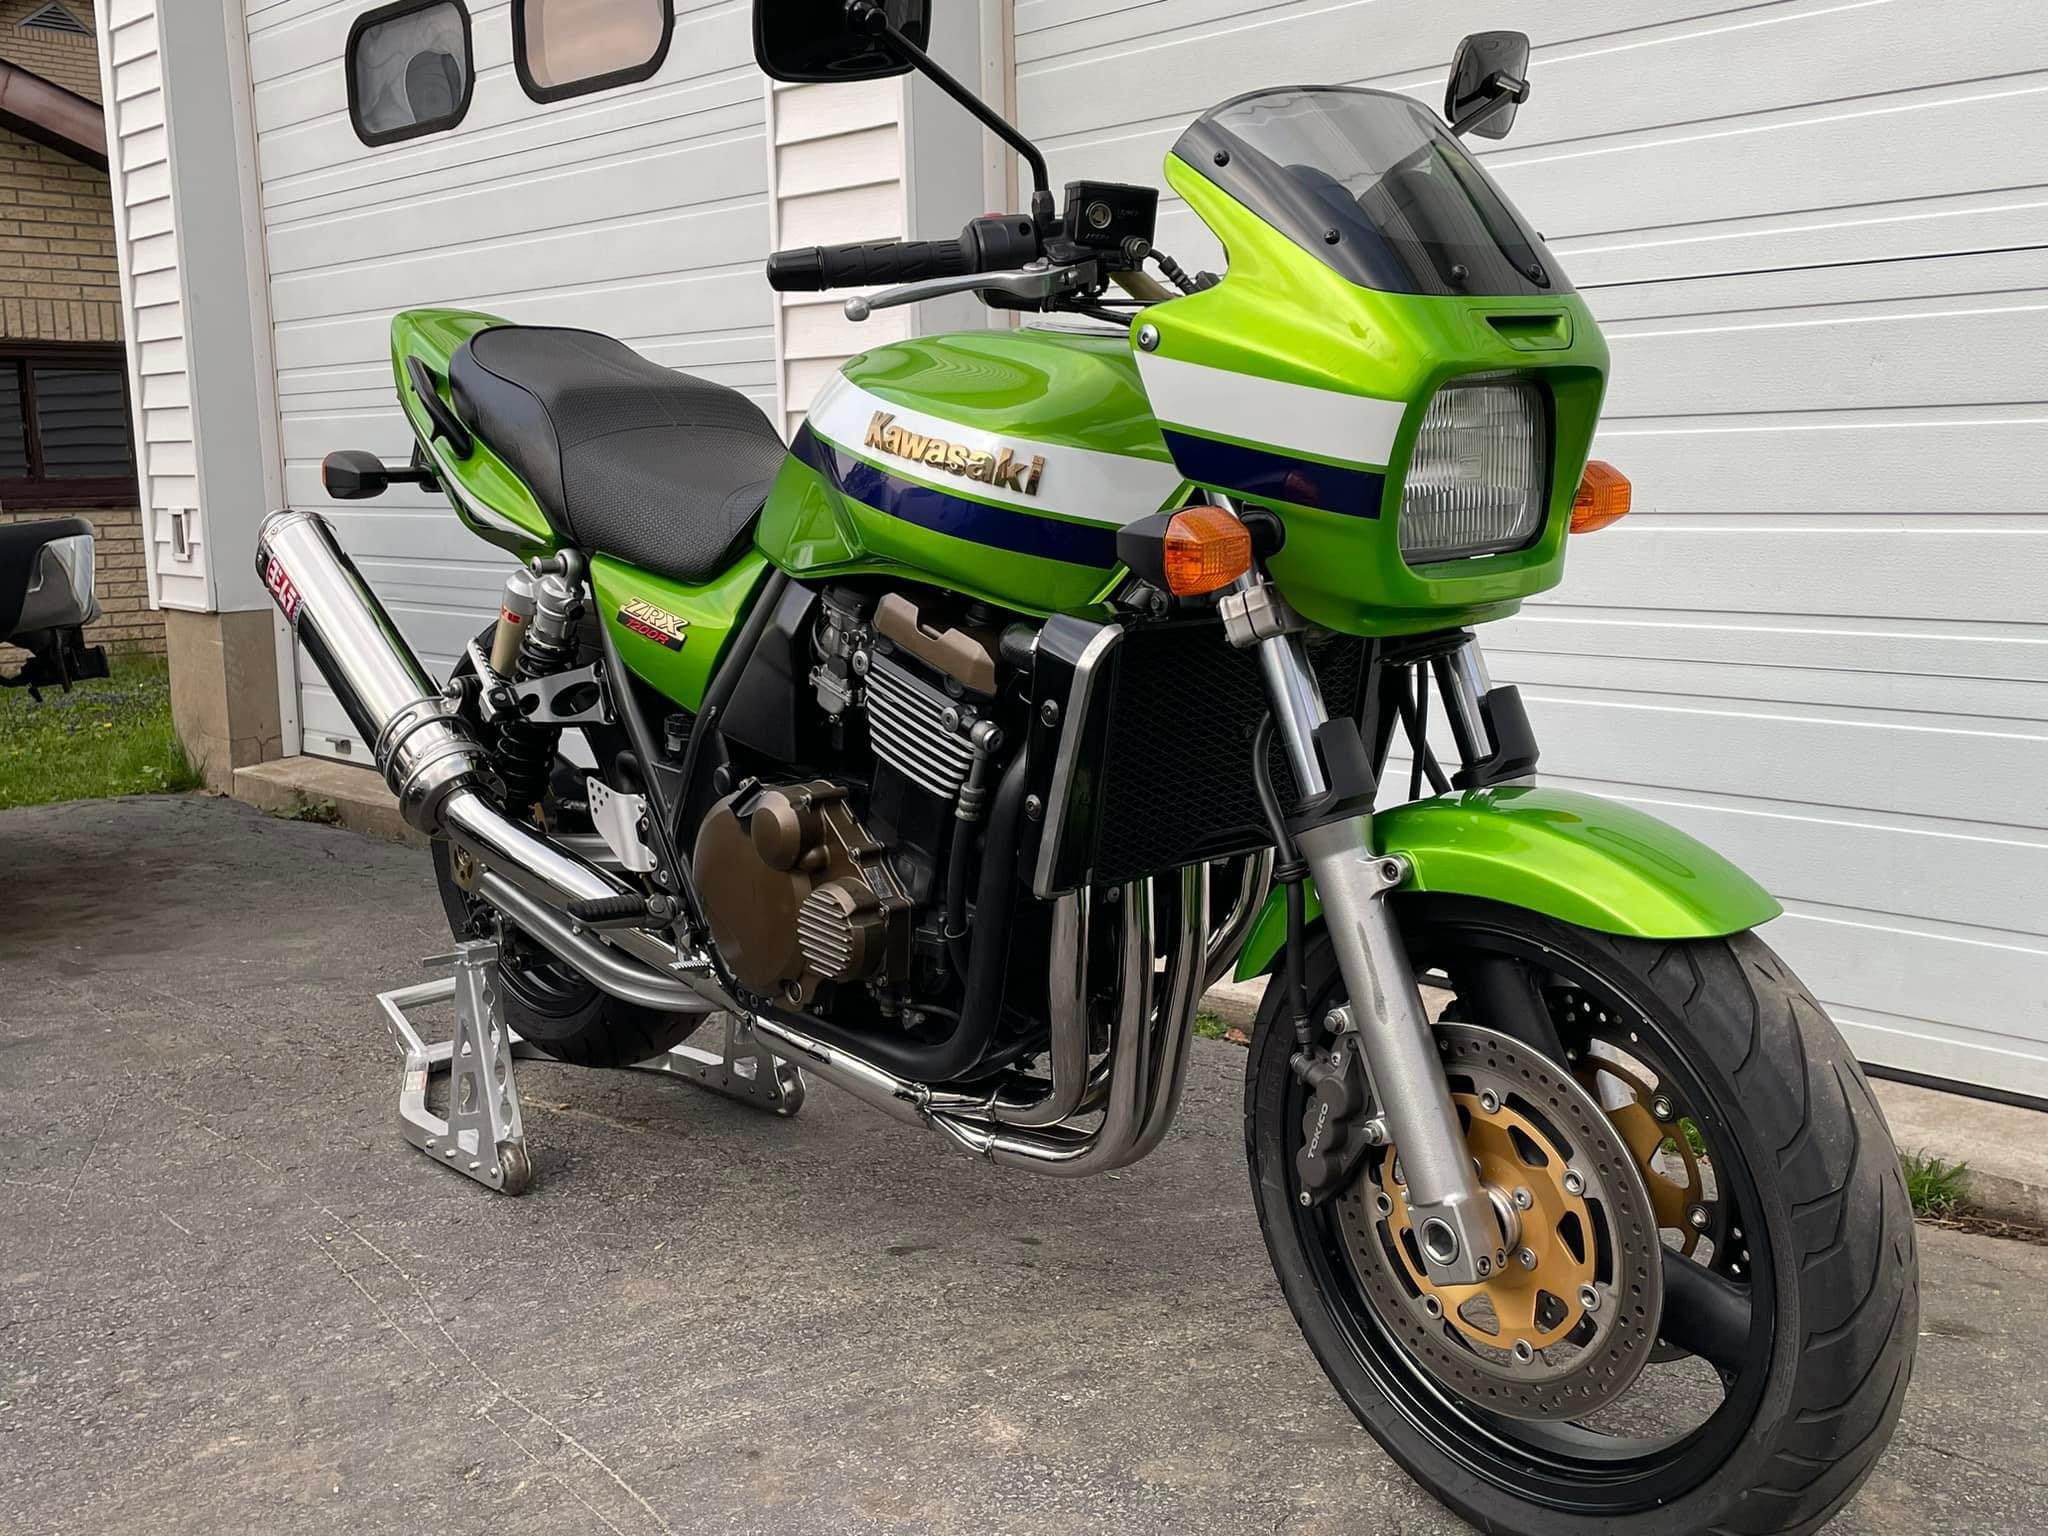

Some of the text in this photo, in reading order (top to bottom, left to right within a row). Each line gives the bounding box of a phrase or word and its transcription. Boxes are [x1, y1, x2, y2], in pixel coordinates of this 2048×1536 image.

[865, 410, 1045, 496] Kawasaki
[622, 598, 686, 638] ZRX
[626, 618, 670, 645] 1200R
[1307, 1102, 1329, 1160] TOKICO
